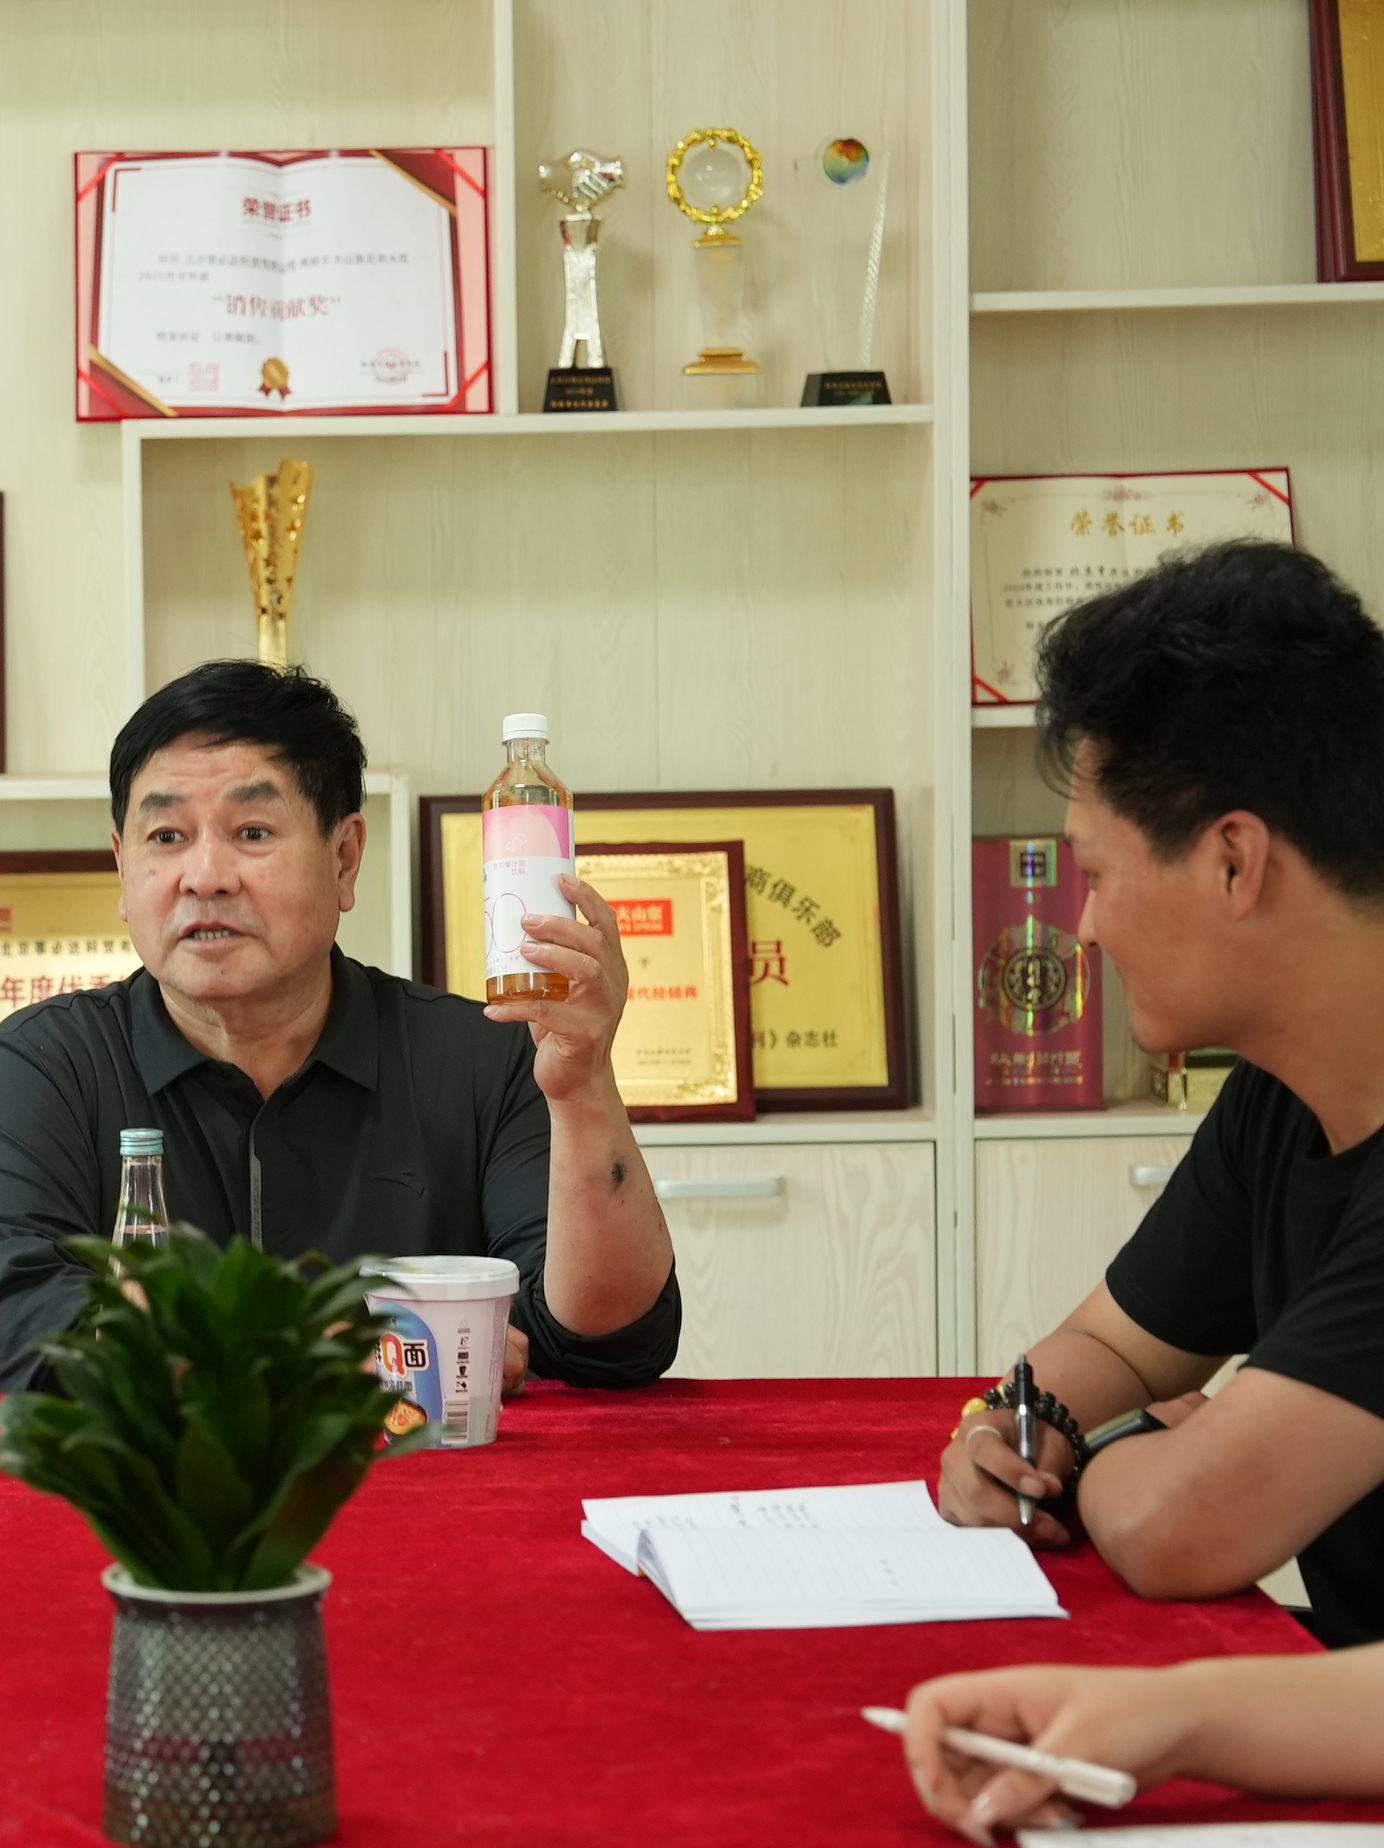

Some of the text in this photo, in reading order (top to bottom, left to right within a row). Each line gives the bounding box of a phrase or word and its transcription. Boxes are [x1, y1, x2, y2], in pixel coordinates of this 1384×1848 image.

[243, 197, 312, 222] 荣誉证书
[1071, 509, 1186, 536] 荣誉证书
